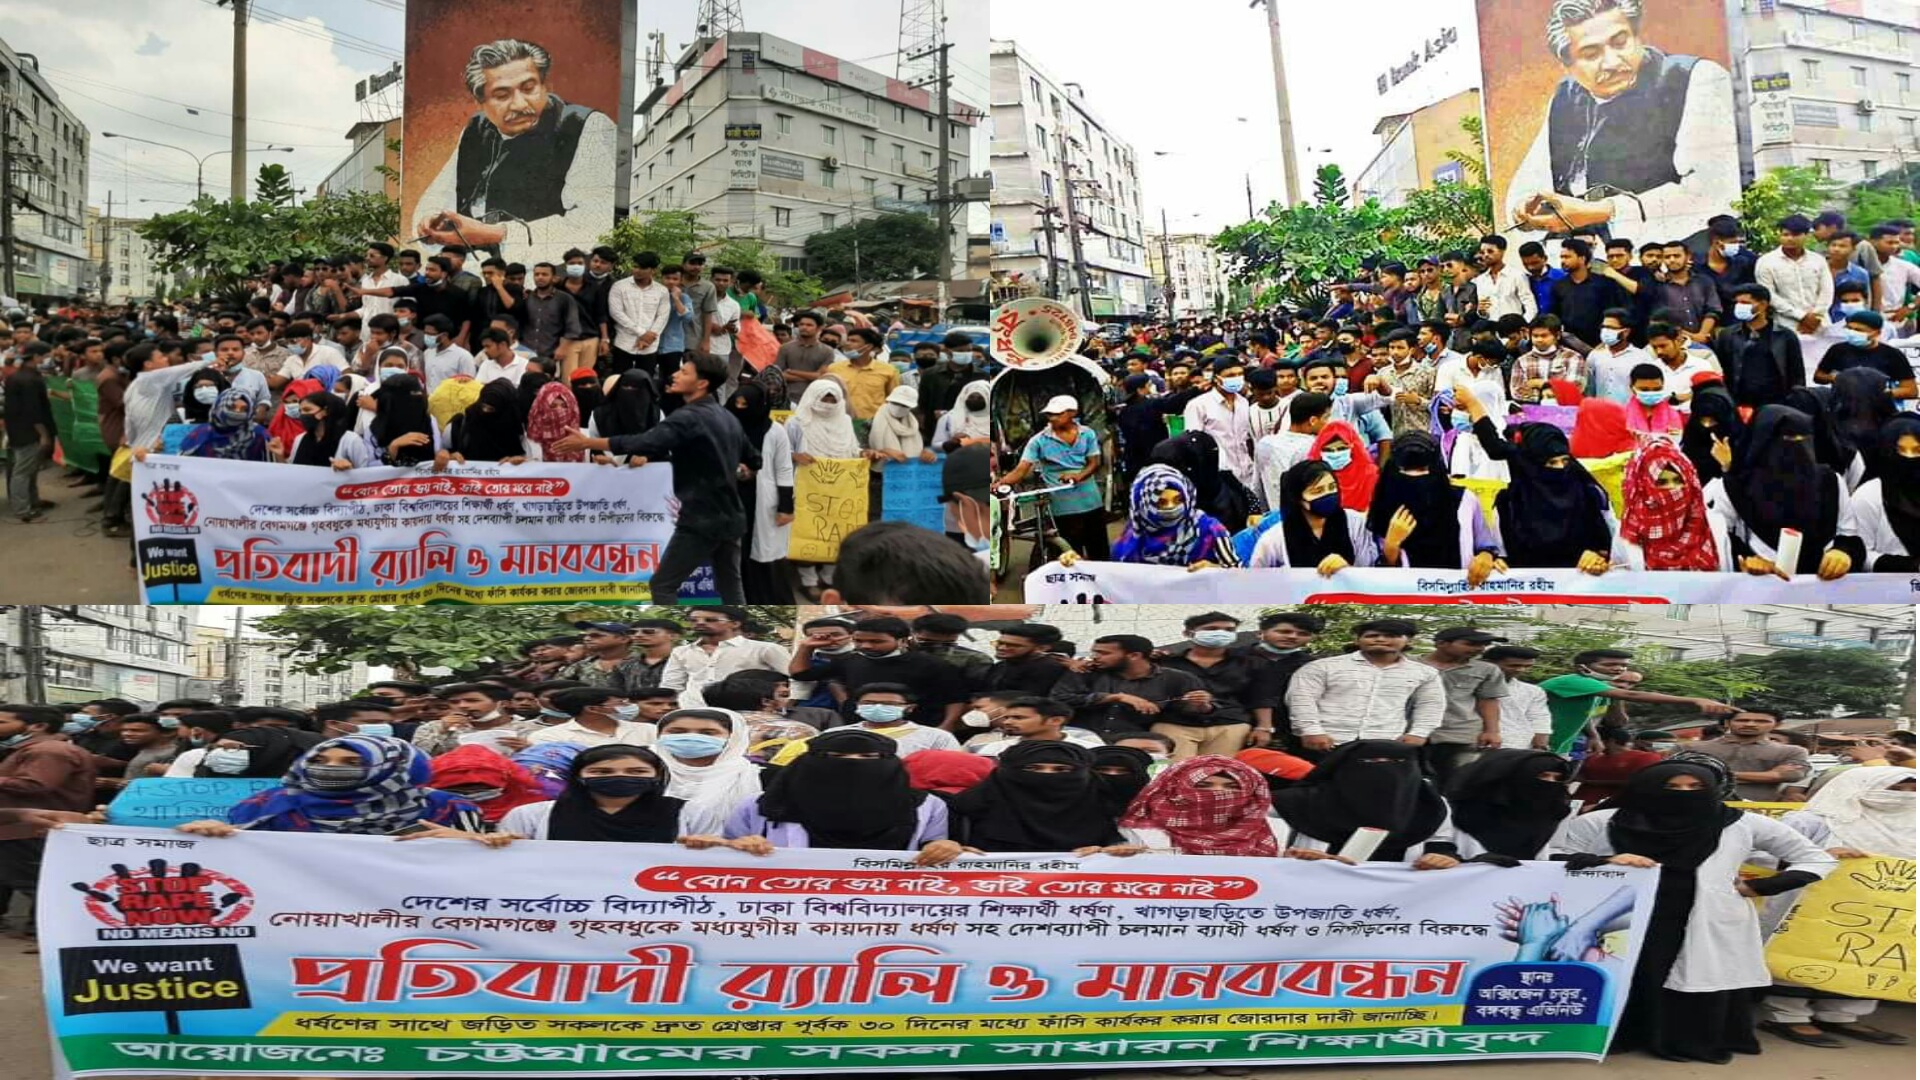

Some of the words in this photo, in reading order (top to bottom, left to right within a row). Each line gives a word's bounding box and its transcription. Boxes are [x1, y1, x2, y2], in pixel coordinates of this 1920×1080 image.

[1424, 26, 1457, 63] Asia
[380, 486, 409, 497] তোর
[414, 482, 431, 494] ভয়
[459, 480, 482, 494] ভাই
[485, 483, 510, 494] তোর
[249, 503, 282, 516] দেশের
[286, 503, 319, 516] সর্বোচ্চ
[374, 503, 395, 514] ঢাকা
[399, 499, 458, 512] বিশ্ববিদ্যালয়ের
[461, 498, 494, 511] শিক্ষার্থী
[523, 500, 573, 513] খাগড়াছড়িতে
[576, 499, 610, 511] উপজাতি
[204, 517, 257, 529] নোয়াখালীর
[260, 519, 307, 531] বেগমগঞ্জে
[356, 516, 398, 531] মধ্যযুগীয়
[401, 514, 433, 528] কায়দায়
[435, 513, 455, 525] ধর্ষণ
[457, 515, 471, 525] সহ
[472, 512, 512, 525] দেশব্যাপী
[515, 515, 544, 525] চলমান
[546, 512, 567, 525] ব্যাধী
[568, 512, 586, 524] ধর্ষণ
[589, 514, 596, 523] ও
[598, 511, 634, 524] নিপীড়নের
[636, 510, 665, 523] বিরুদ্ধে
[147, 546, 165, 558] We
[167, 547, 188, 558] want
[213, 535, 360, 584] প্রতিবাদী
[467, 548, 488, 575] ও
[500, 543, 661, 575] মানববন্ধন
[143, 560, 198, 580] Justice
[1045, 573, 1066, 583] ছাত্র
[400, 591, 421, 604] পূর্বক
[435, 583, 462, 596] দিনের
[465, 588, 484, 599] মধ্যে
[487, 585, 507, 598] ফাঁসি
[510, 585, 538, 597] কার্যকর
[541, 586, 562, 596] করার
[564, 585, 597, 596] জোরদার
[599, 583, 617, 595] দাবী
[1529, 578, 1555, 591] রহীম
[86, 836, 126, 848] ছাত্র
[134, 836, 198, 850] সমাজ
[957, 858, 1032, 871] রাহমানির
[1038, 860, 1080, 871] রহীম
[118, 877, 212, 894] STOP
[760, 876, 833, 891] তোর
[843, 877, 892, 893] ভয়
[969, 875, 1032, 894] ভাই
[1039, 879, 1106, 894] তোর
[1110, 881, 1168, 896] মরে
[118, 893, 213, 909] RAPE
[402, 894, 491, 913] দেশের
[498, 893, 596, 913] সর্বোচ্চ
[737, 900, 795, 917] ঢাকা
[803, 898, 973, 918] বিশ্ববিদ্যালয়ের
[980, 899, 1057, 919] শিক্ষার্থী
[1135, 903, 1267, 921] খাগড়াছড়িতে
[1273, 904, 1357, 921] উপজাতি
[126, 908, 212, 926] NOW
[269, 910, 422, 929] নোয়াখালীর
[432, 916, 557, 933] বেগমগঞ্জে
[569, 918, 681, 938] গৃহবধুকে
[692, 917, 798, 939] মধ্যযুগীয়
[808, 921, 900, 937] কায়দায়
[909, 920, 958, 937] ধর্ষণ
[966, 921, 1000, 937] সহ
[1009, 918, 1110, 937] দেশব্যাপী
[1118, 923, 1187, 938] চলমান
[1197, 919, 1248, 938] ব্যাধী
[1255, 922, 1298, 938] ধর্ষণ
[1305, 925, 1319, 938] ও
[1325, 920, 1410, 938] নিপীড়নের
[1420, 920, 1491, 938] বিরুদ্ধে
[1826, 901, 1916, 936] ST
[104, 929, 133, 939] NO
[140, 928, 215, 939] MEANS
[221, 927, 249, 937] NO
[93, 959, 138, 973] We
[145, 957, 214, 973] want
[291, 936, 690, 1003] প্রতিবাদী
[719, 942, 960, 1009] র‍্যালি
[988, 964, 1048, 1001] ও
[1077, 962, 1468, 1002] মানববন্ধন
[75, 979, 239, 1003] Justice
[1478, 984, 1546, 1000] অক্সিজেন
[1475, 1005, 1524, 1020] বঙ্গবন্ধু
[1527, 1001, 1586, 1017] এভিনিউ
[295, 1016, 377, 1032] ধর্ষণের
[388, 1016, 449, 1032] সাথে
[460, 1016, 537, 1034] জড়িত
[547, 1018, 644, 1032] সকলকে
[651, 1018, 703, 1033] দ্রুত
[711, 1019, 782, 1034] গ্রেপ্তার
[794, 1017, 851, 1036] পূর্বক
[860, 1021, 894, 1031] ৩০
[904, 1016, 971, 1031] দিনের
[980, 1016, 1028, 1031] মধ্যে
[1038, 1014, 1086, 1029] ফাঁসি
[1094, 1013, 1162, 1029] কার্যকর
[1172, 1013, 1219, 1027] করার
[1227, 1012, 1307, 1026] জোরদার
[1315, 1009, 1354, 1024] দাবী
[112, 1041, 385, 1063] আয়োজনেঃ
[416, 1040, 762, 1065] চট্টগ্রামের
[783, 1042, 974, 1062] সকল
[993, 1038, 1226, 1059] সাধারন
[1245, 1027, 1550, 1053] শিক্ষার্থীবৃন্দ
